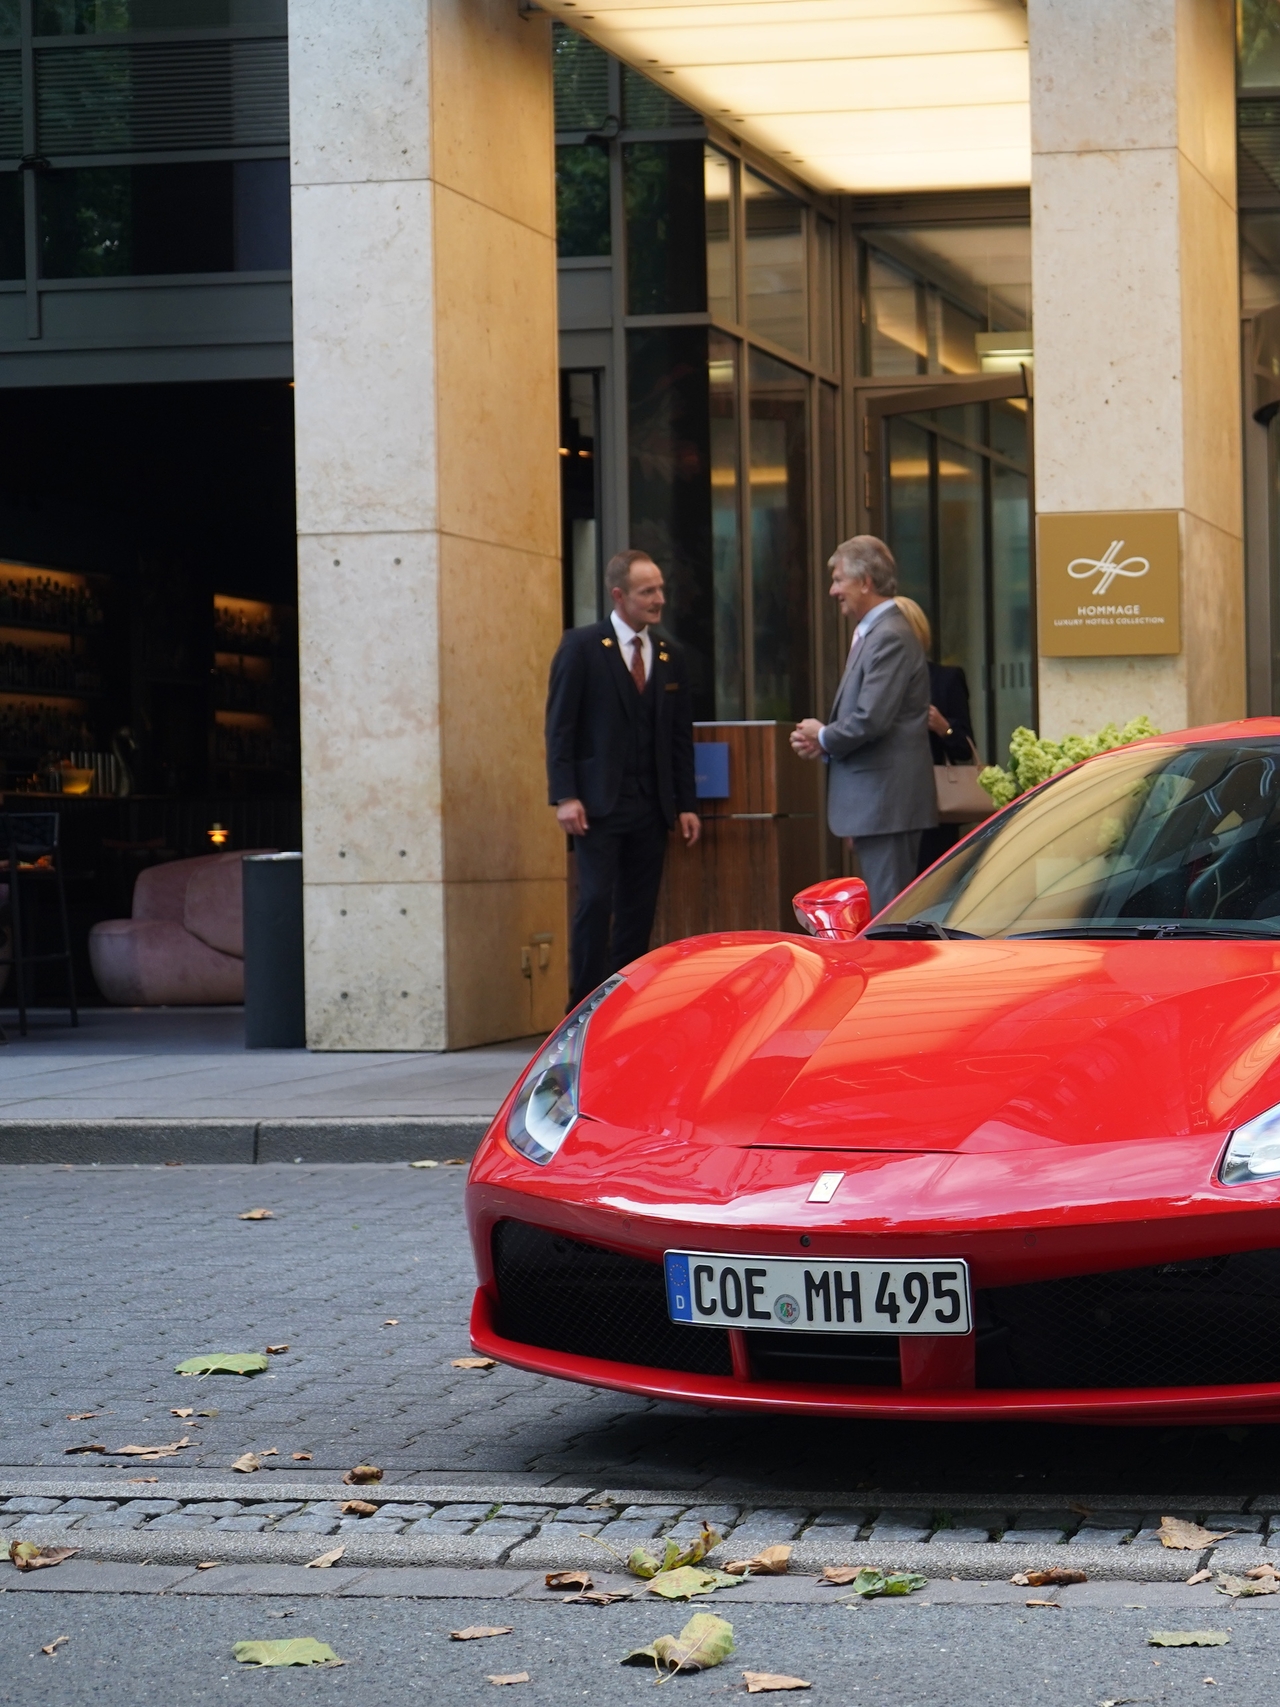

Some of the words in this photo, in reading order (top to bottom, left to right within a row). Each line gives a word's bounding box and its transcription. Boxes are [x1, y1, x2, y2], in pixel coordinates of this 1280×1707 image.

[1077, 605, 1140, 616] HOMMAGE
[1054, 618, 1083, 627] LUXURY
[1085, 617, 1114, 626] HOTELS
[1115, 616, 1165, 626] COLLECTION
[693, 1264, 772, 1321] COE
[804, 1269, 862, 1323] MH
[875, 1271, 961, 1325] 495
[676, 1295, 685, 1310] D
